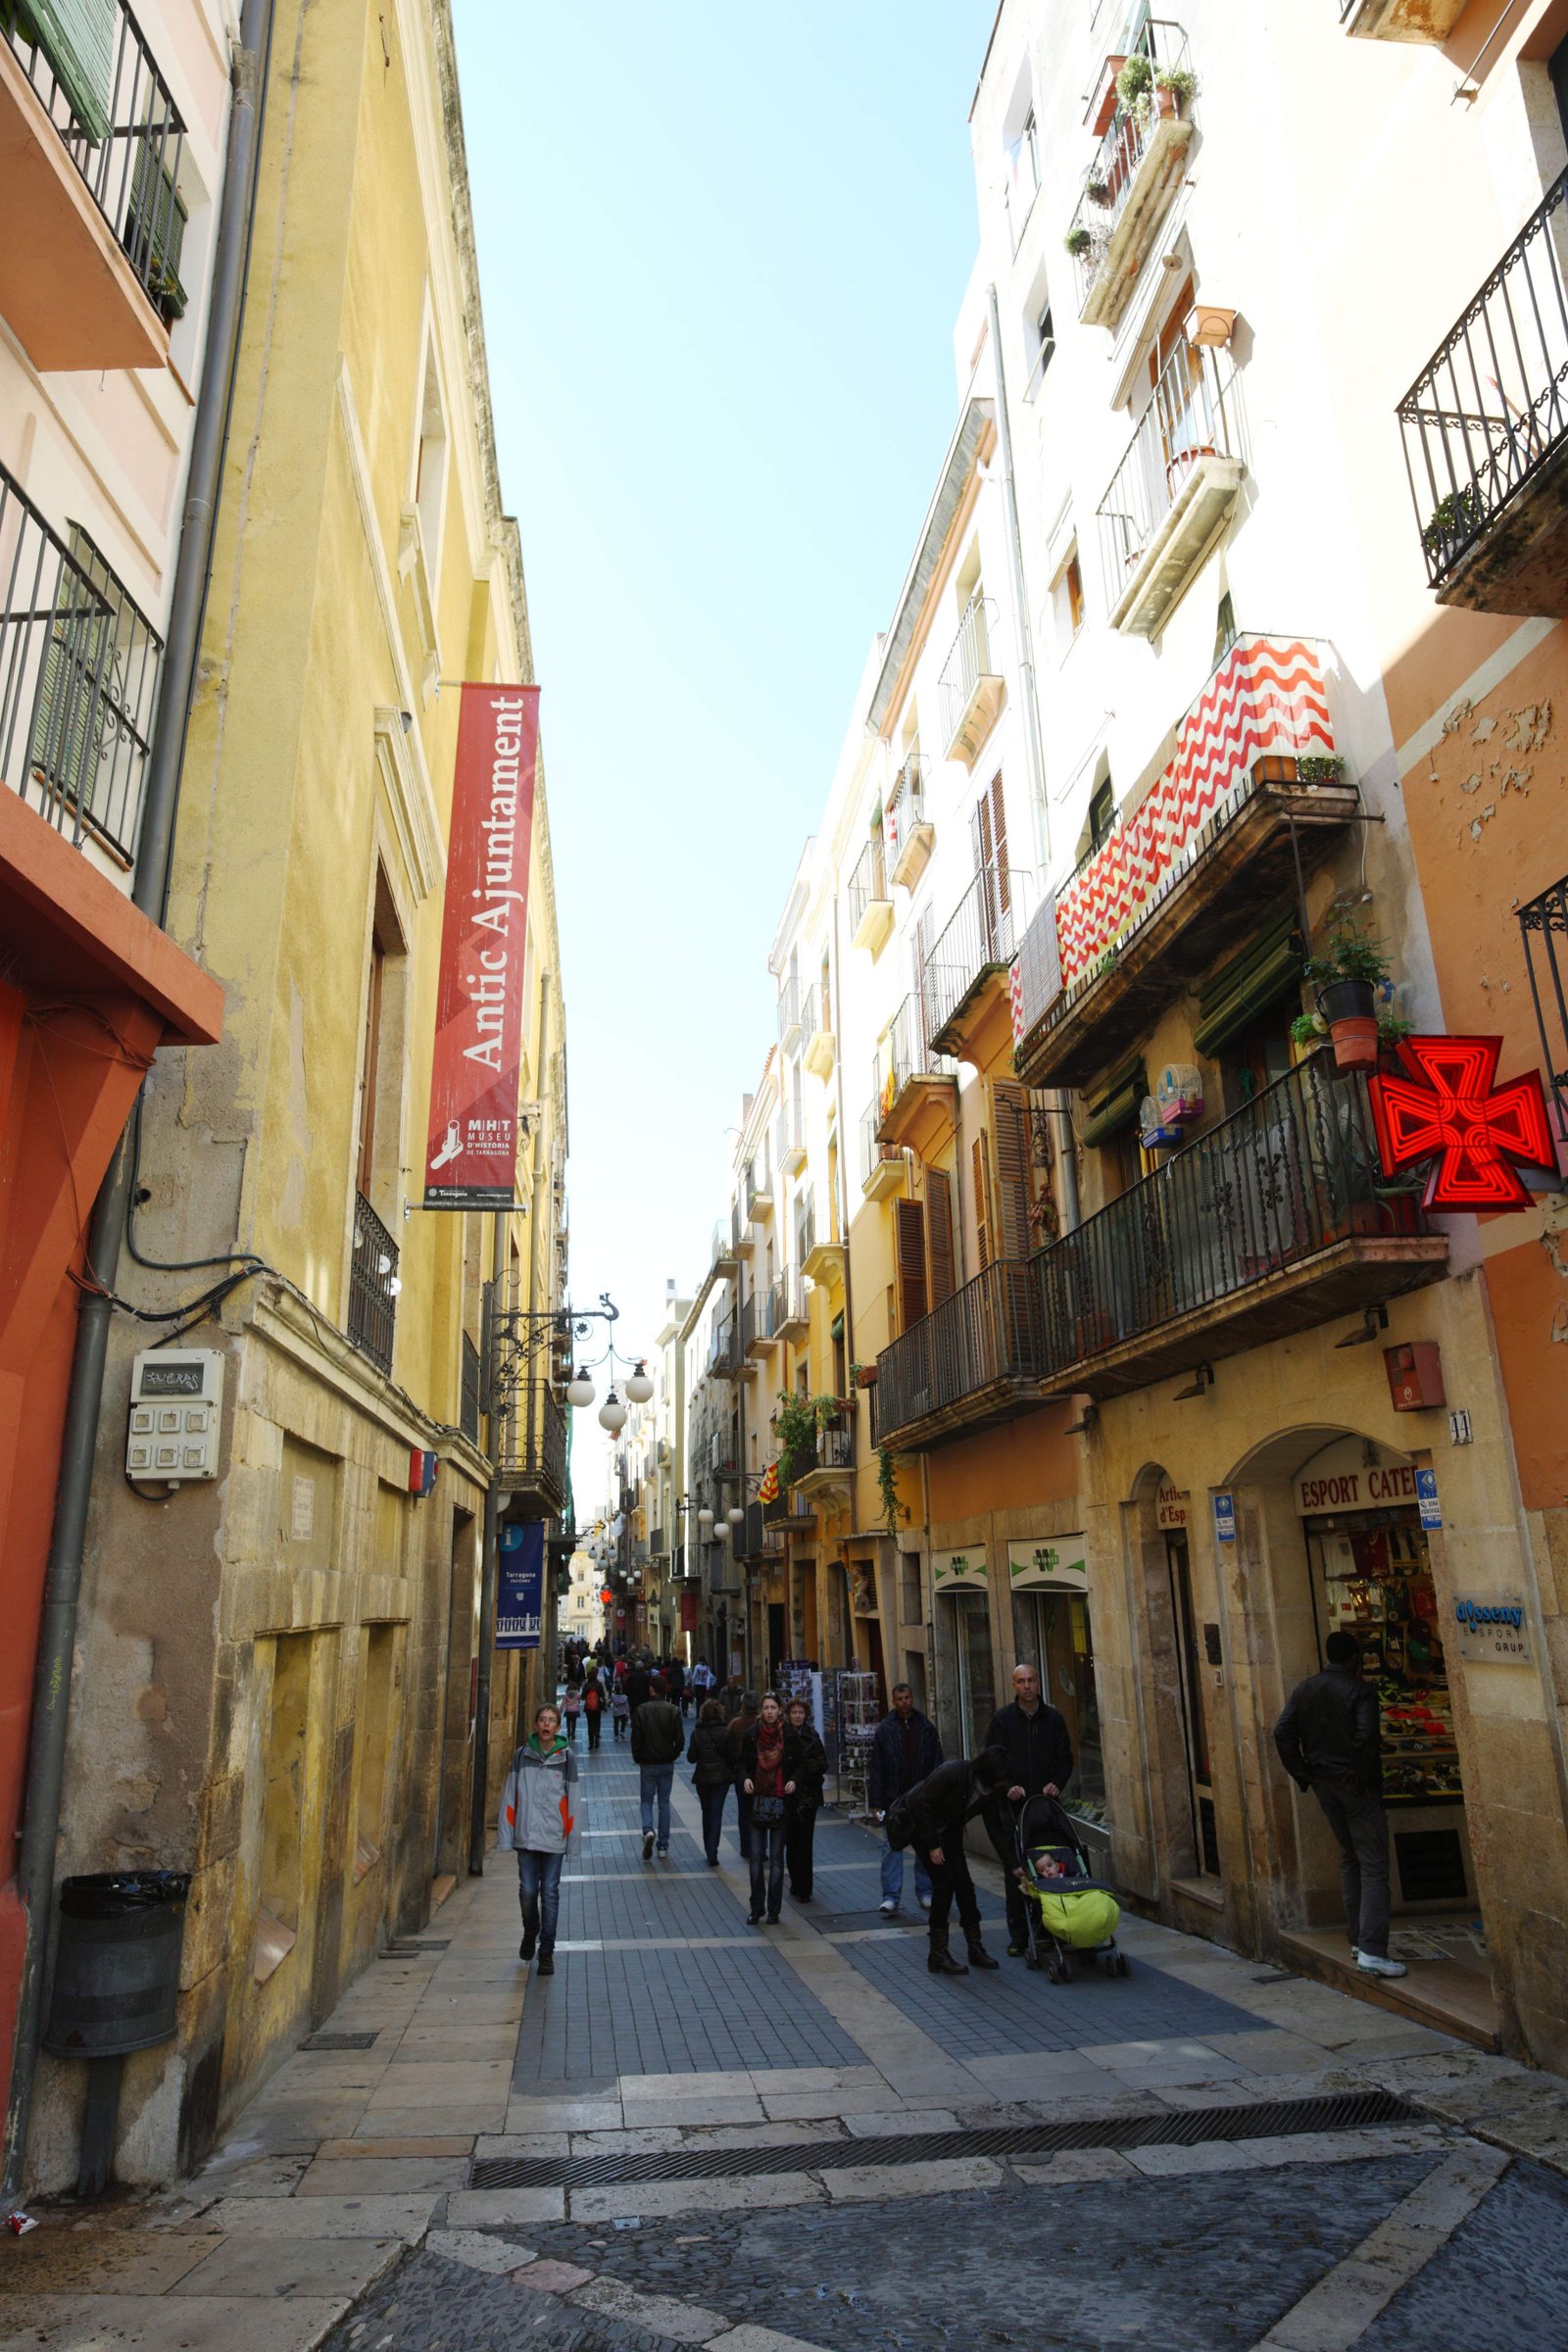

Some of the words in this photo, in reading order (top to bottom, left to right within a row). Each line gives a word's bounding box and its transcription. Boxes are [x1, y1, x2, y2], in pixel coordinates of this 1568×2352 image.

[471, 696, 524, 937] Ajuntament
[463, 951, 508, 1073] Antic
[467, 1132, 511, 1141] MUSEU
[1300, 1474, 1359, 1508] ESPORT
[1160, 1505, 1186, 1525] d'Esp
[1463, 1627, 1521, 1640] ESPORT
[1495, 1642, 1524, 1652] GRUP
